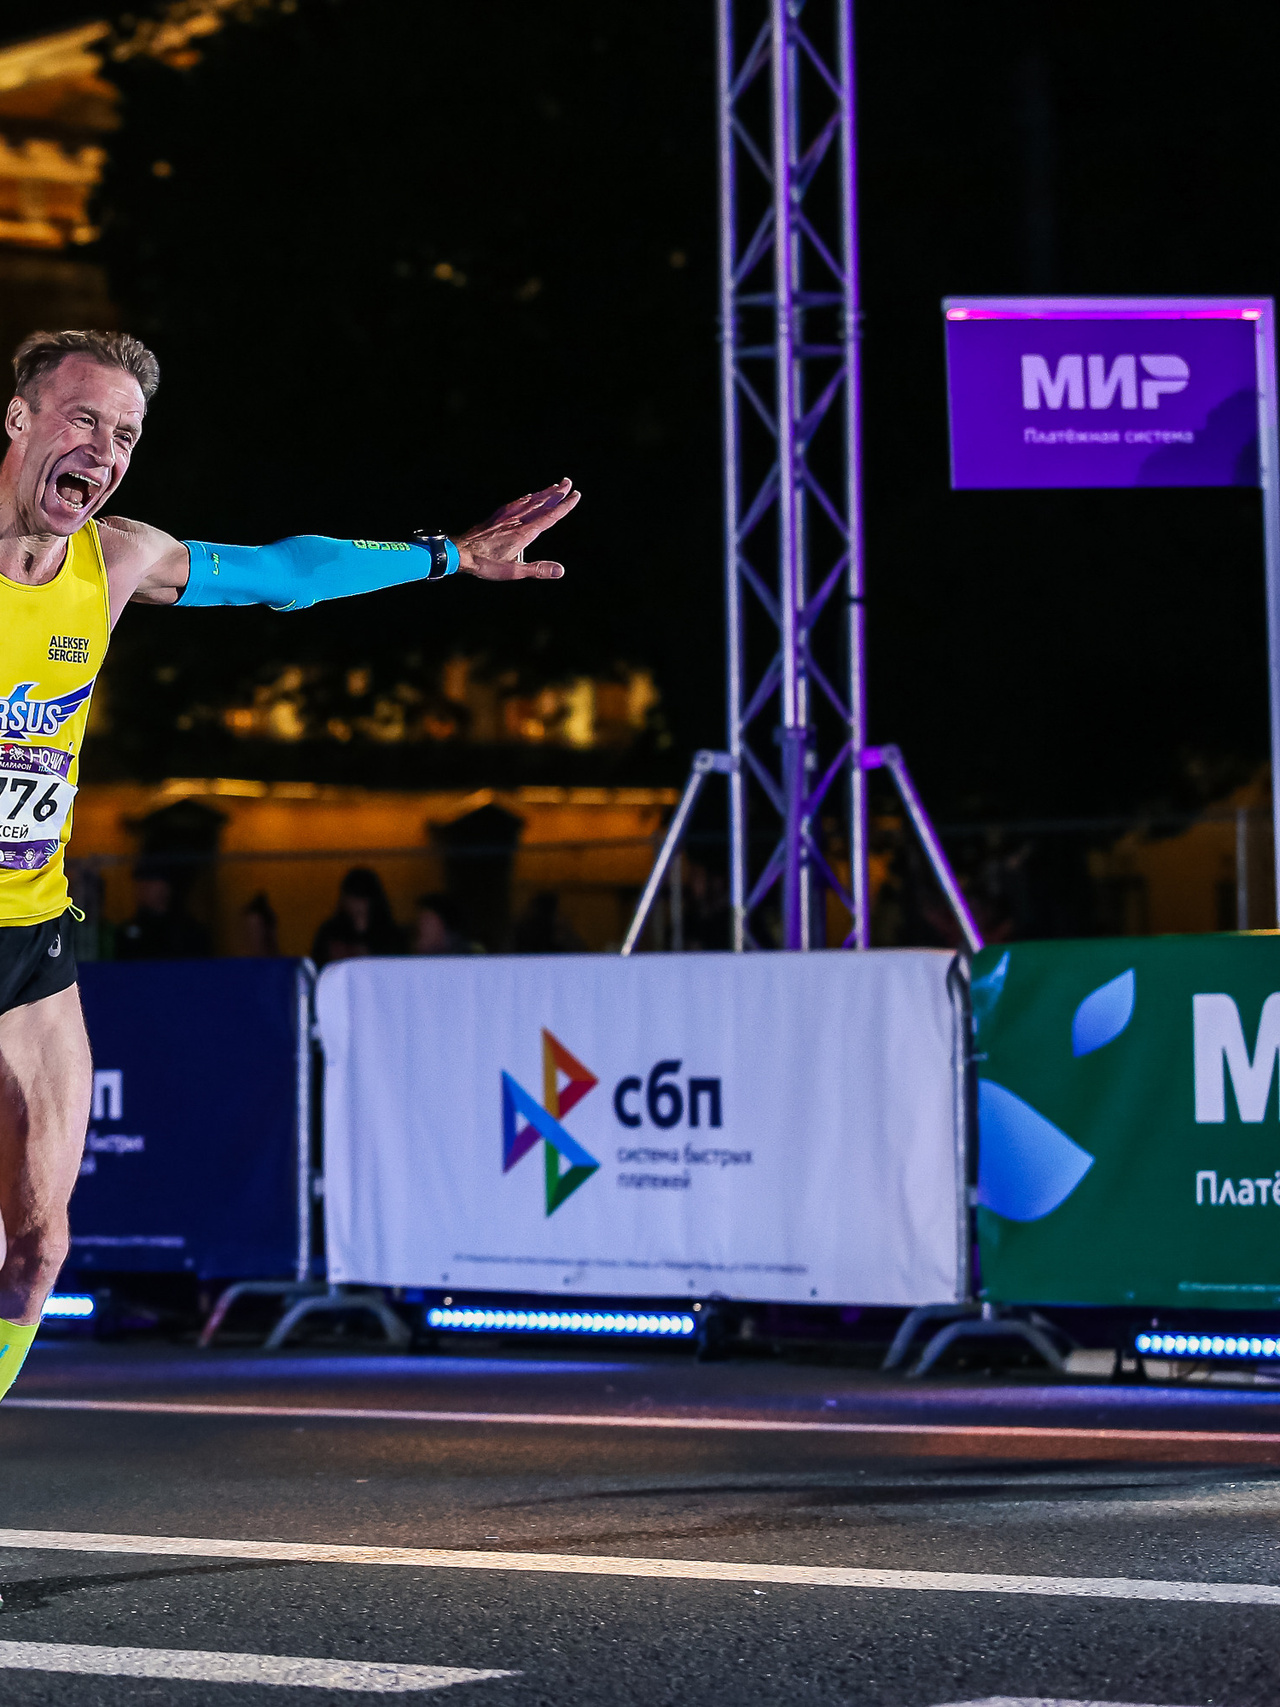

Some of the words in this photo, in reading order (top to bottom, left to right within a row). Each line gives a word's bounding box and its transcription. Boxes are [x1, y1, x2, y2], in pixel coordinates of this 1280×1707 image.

[1020, 353, 1191, 410] МИР
[1023, 427, 1120, 444] Платёжная
[1125, 430, 1195, 444] система
[48, 634, 90, 651] ALEKSEY
[47, 648, 90, 665] SERGEEV
[617, 1147, 679, 1164] система
[684, 1143, 753, 1168] быстрых
[617, 1169, 692, 1189] платежей
